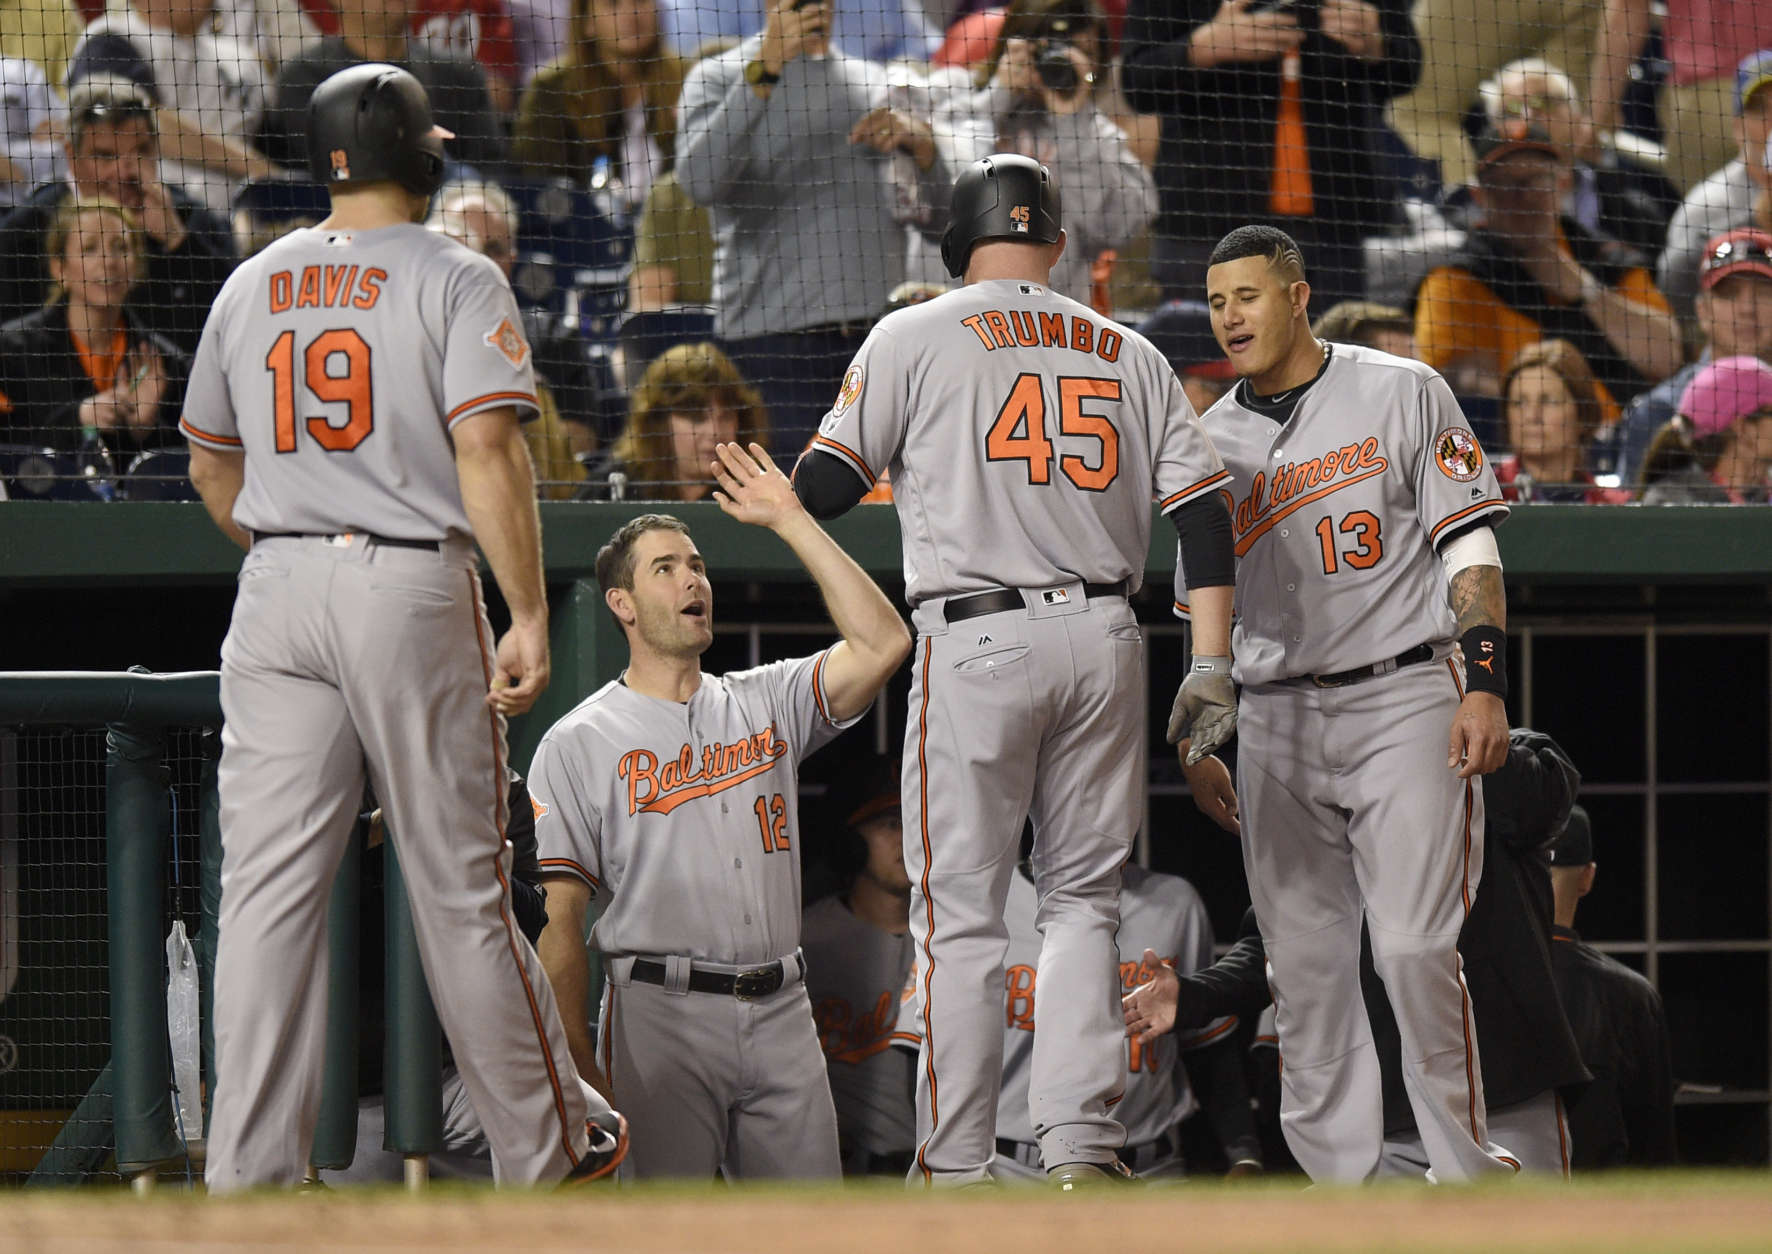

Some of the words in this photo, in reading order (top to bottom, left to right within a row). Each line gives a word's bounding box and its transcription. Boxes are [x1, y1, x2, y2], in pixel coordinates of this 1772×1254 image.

[330, 150, 348, 168] 19
[1010, 206, 1030, 221] 45
[269, 264, 388, 314] DAVIS
[960, 309, 1123, 363] TRUMBO
[266, 328, 374, 454] 19
[985, 372, 1122, 493] 45
[1315, 509, 1383, 575] 13
[1480, 640, 1494, 653] 13
[754, 793, 790, 853] 12
